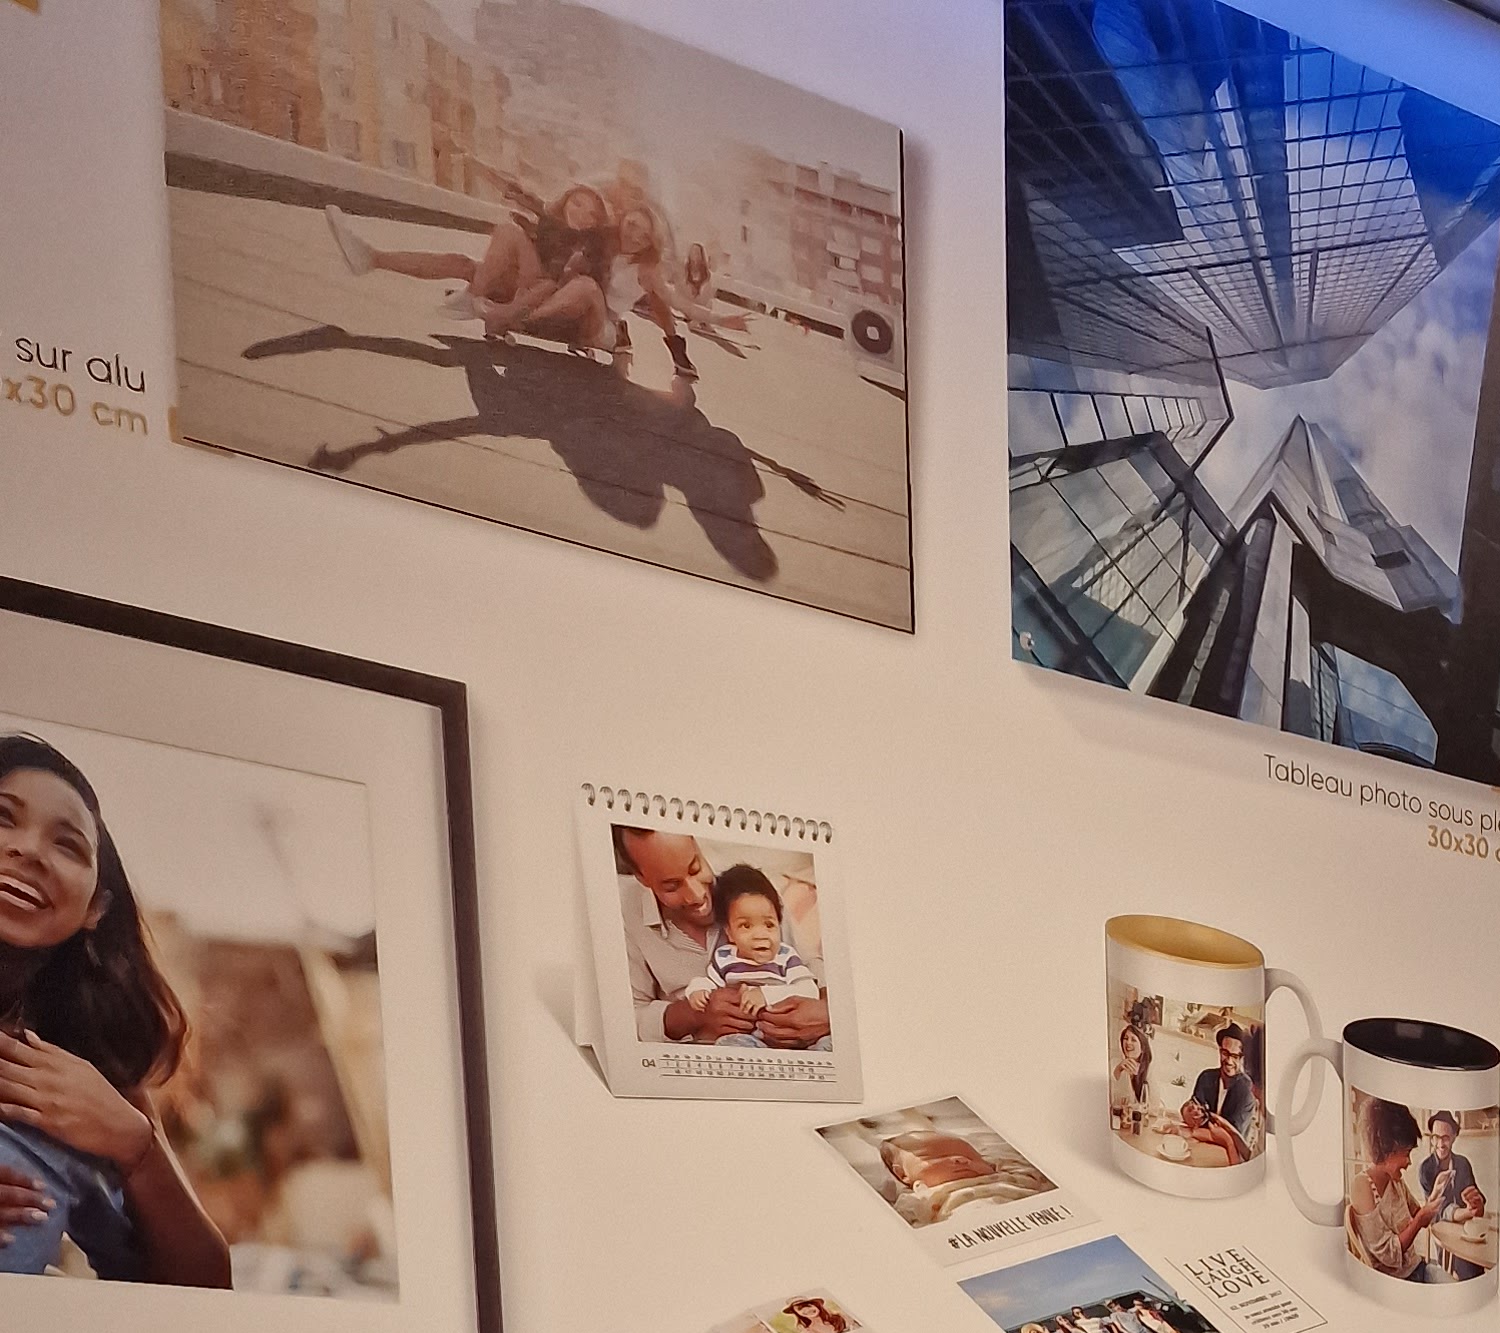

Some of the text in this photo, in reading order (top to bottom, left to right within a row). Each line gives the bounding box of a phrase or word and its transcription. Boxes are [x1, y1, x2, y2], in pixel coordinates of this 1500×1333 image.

[15, 337, 146, 393] sur alu
[92, 402, 148, 435] cm
[1263, 753, 1352, 798] Tableau
[1360, 782, 1422, 814] photo
[1428, 801, 1474, 827] sous
[1427, 824, 1489, 860] 30x30
[972, 1216, 1032, 1243] NOUVELLE
[1183, 1248, 1246, 1277] LIVE
[1196, 1258, 1256, 1286] LAUGH
[1207, 1270, 1270, 1299] LOVE
